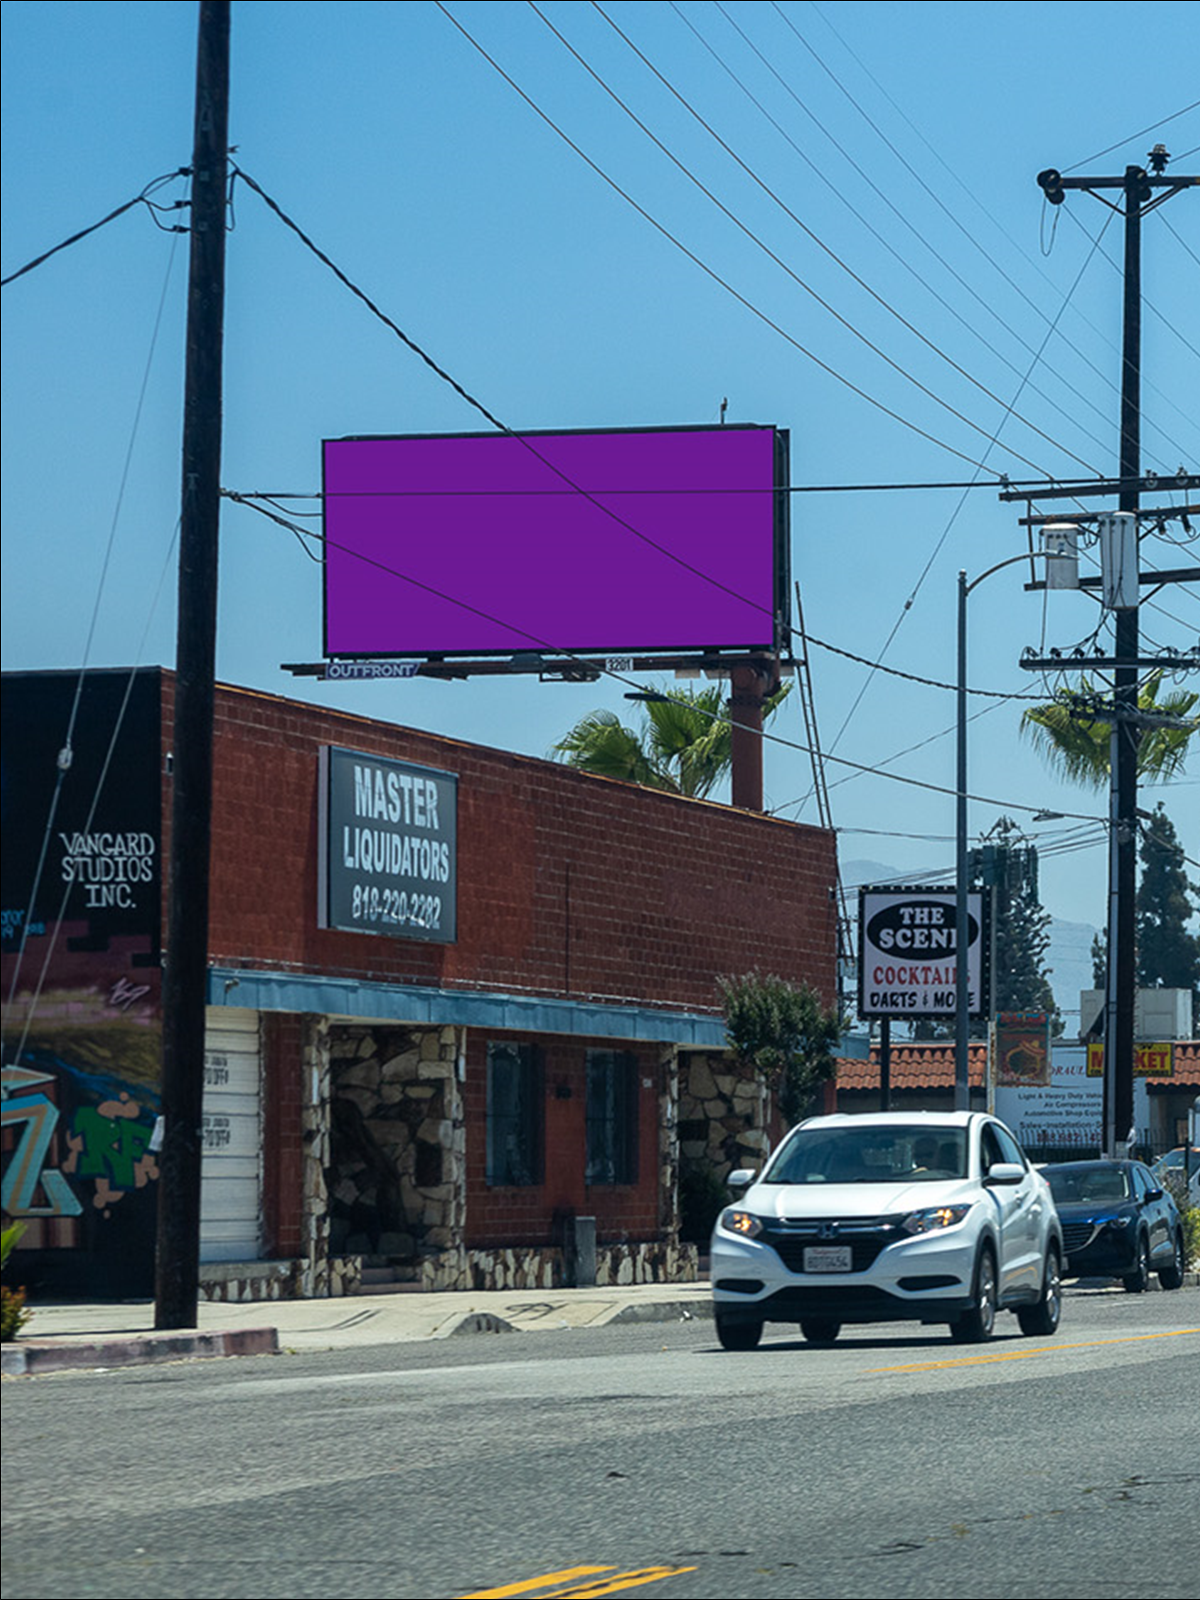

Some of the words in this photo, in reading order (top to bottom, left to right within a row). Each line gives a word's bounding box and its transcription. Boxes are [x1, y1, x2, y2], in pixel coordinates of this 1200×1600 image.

[329, 664, 414, 677] OUTFRONT
[354, 765, 439, 830] MASTER
[58, 832, 155, 857] VANGARD
[343, 826, 449, 883] LIQUIDATORS
[62, 856, 153, 882] STUDIOS
[84, 883, 137, 908] INC.
[899, 907, 945, 925] THE
[873, 966, 970, 985] COCKTAI
[870, 991, 918, 1008] DARTS
[933, 991, 975, 1008] MOE
[1090, 1050, 1169, 1069] MKET
